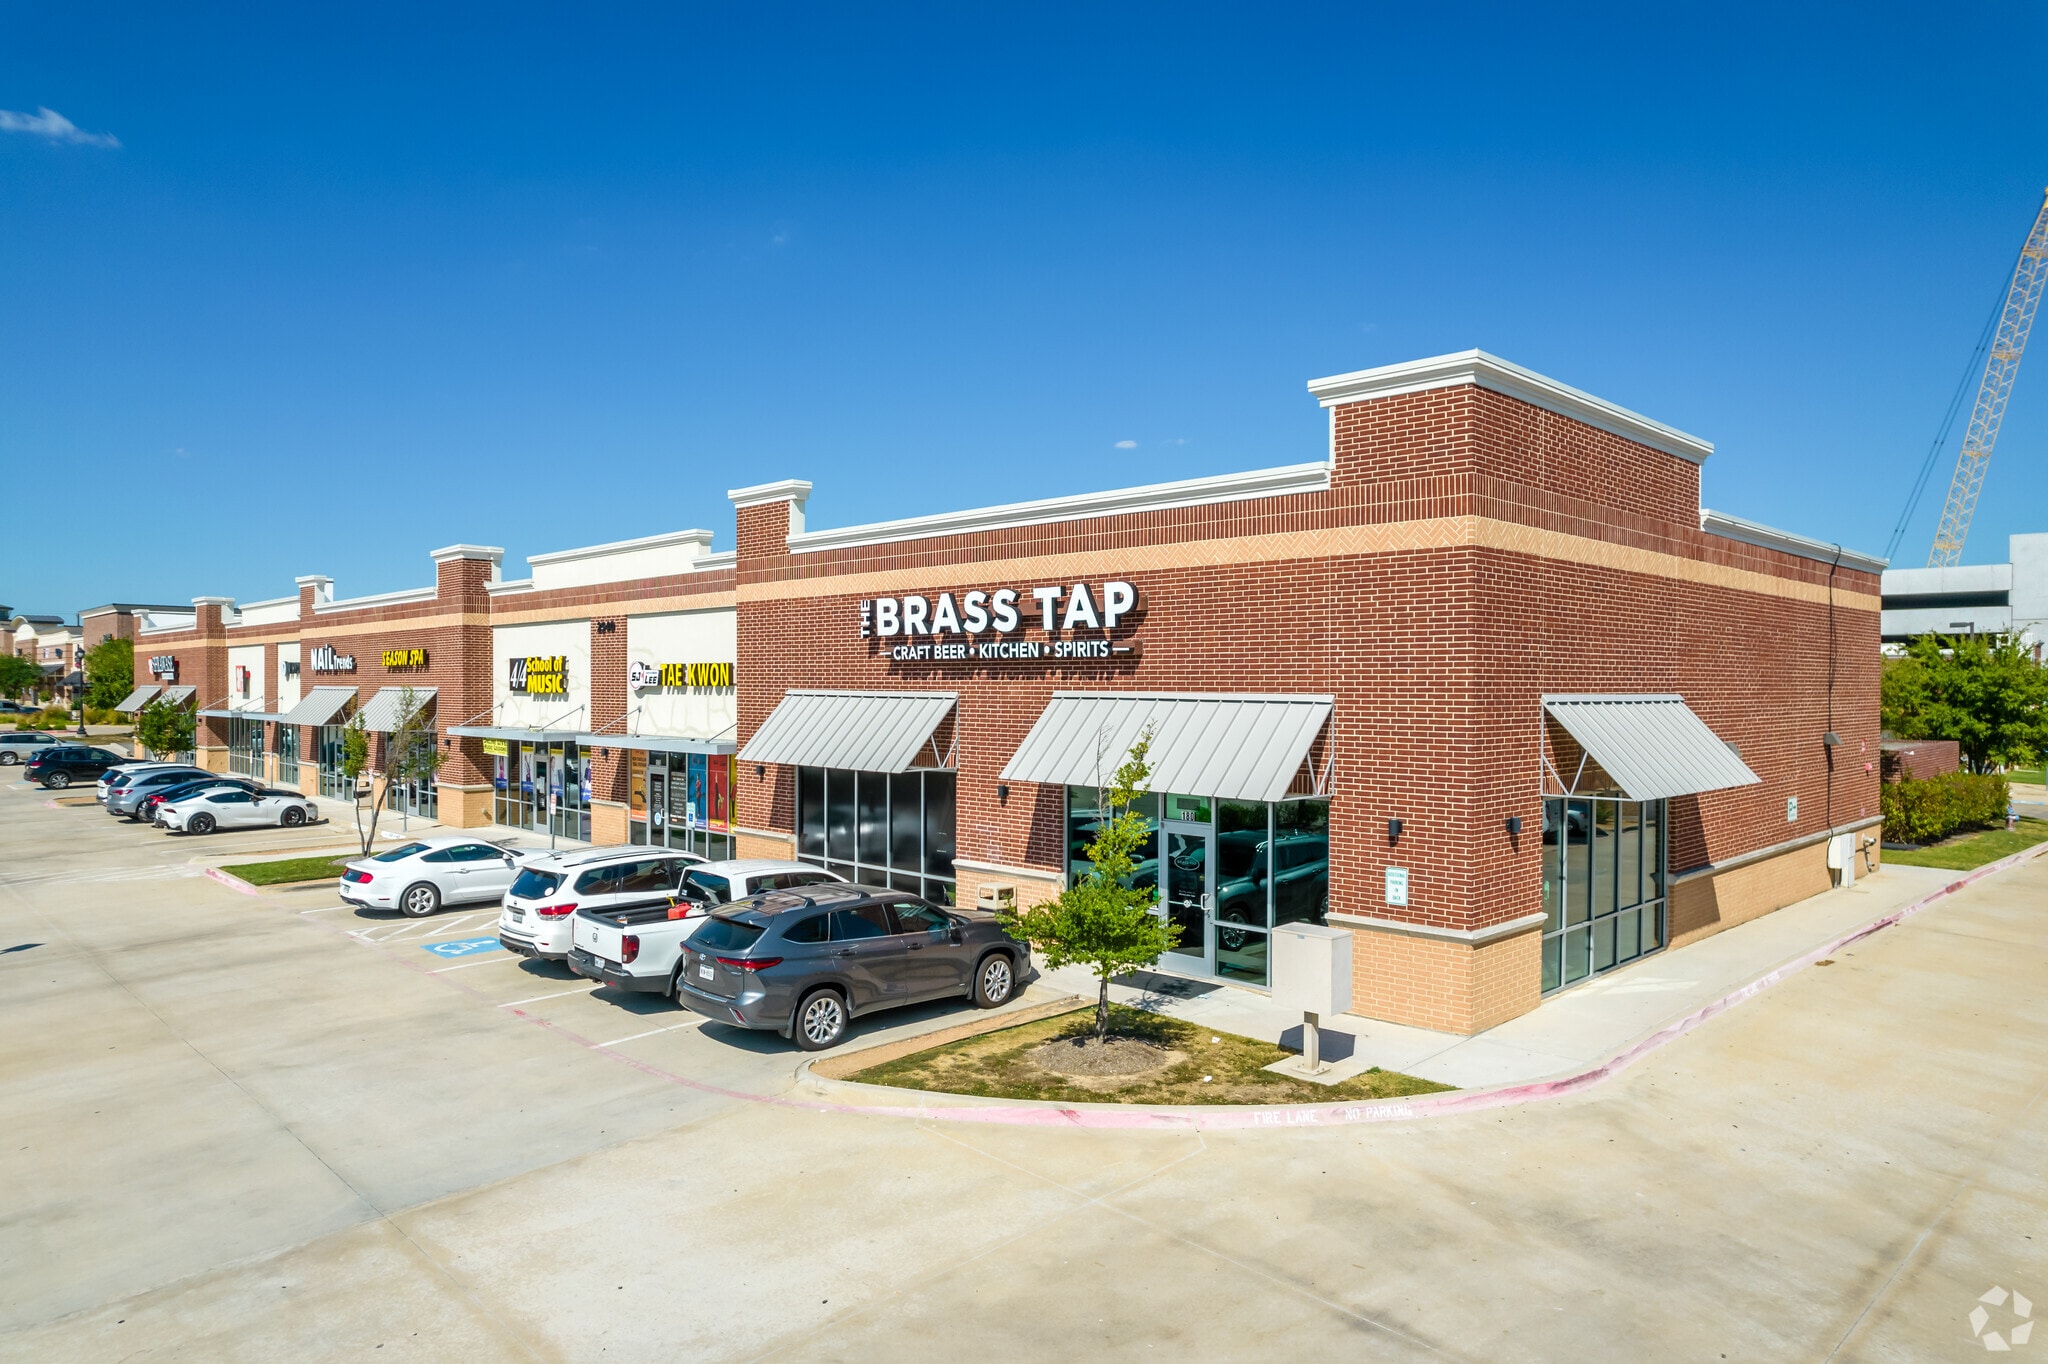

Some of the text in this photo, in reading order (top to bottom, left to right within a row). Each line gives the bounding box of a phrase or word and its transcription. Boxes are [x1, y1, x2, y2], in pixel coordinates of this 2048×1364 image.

[860, 581, 1135, 639] THE BRASS TAP
[382, 648, 424, 667] SEASON SPA
[893, 640, 1109, 660] CRAFT BEER KITCHEN SPIRITS
[510, 659, 527, 689] 4/4
[527, 655, 563, 673] School of
[660, 662, 730, 687] TAE KWON
[527, 674, 563, 693] MUSIC
[1253, 1103, 1413, 1125] FIRE LANE NO PARKING
